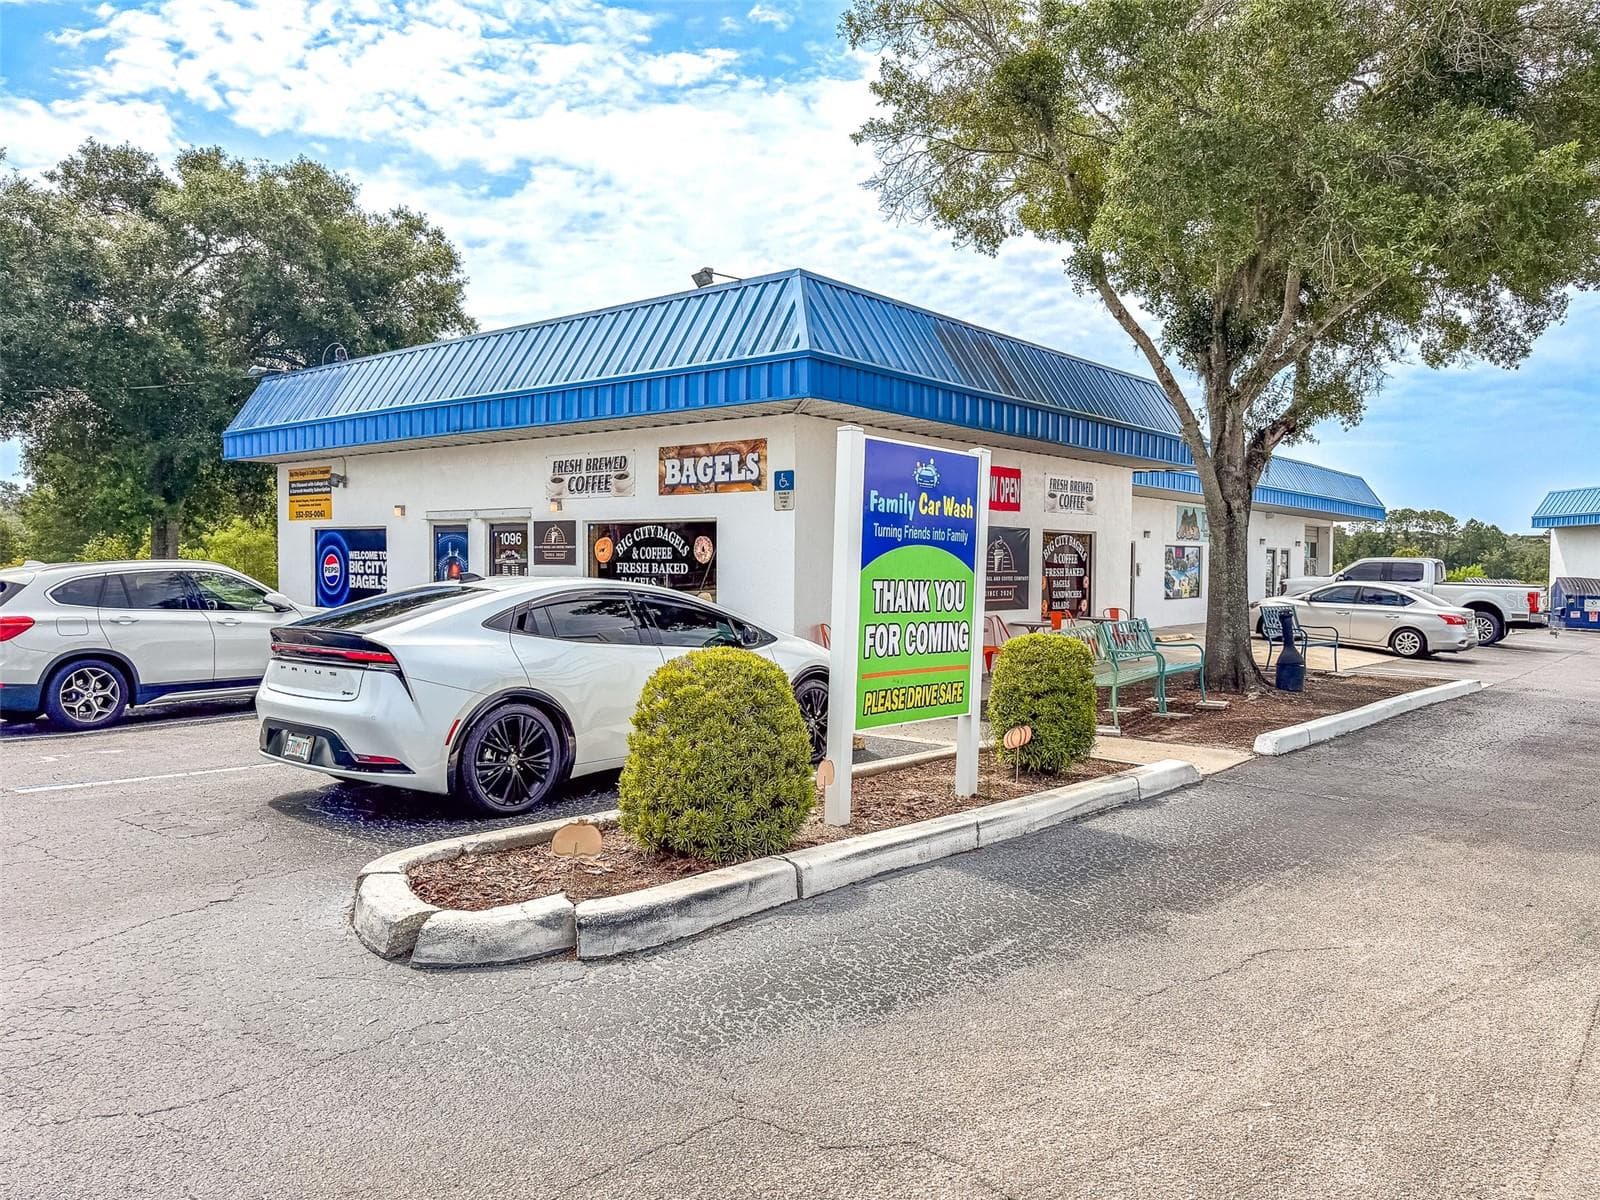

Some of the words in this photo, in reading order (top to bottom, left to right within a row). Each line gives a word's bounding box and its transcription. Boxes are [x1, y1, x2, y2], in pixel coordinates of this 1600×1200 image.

[552, 458, 582, 474] FRESH
[585, 455, 628, 472] BREWED
[664, 452, 760, 486] BAGELS
[567, 474, 612, 494] COFFEE
[999, 476, 1020, 504] OPEN
[1049, 477, 1069, 491] FRESH
[1069, 480, 1094, 493] BREWED
[869, 489, 916, 521] Family
[918, 491, 942, 516] Car
[943, 495, 974, 519] Wash
[1059, 493, 1086, 509] COFFEE
[499, 532, 522, 545] 1096
[615, 533, 634, 558] BIG
[633, 524, 657, 542] CITY
[657, 525, 690, 558] BAGELS
[873, 522, 903, 542] Turning
[903, 524, 931, 540] Friends
[932, 527, 946, 541] into
[946, 528, 969, 546] Family
[348, 550, 378, 560] WELCOME
[378, 550, 388, 560] TO
[632, 546, 639, 560] &
[639, 546, 673, 560] COFFEE
[1042, 540, 1056, 561] BIG
[1054, 534, 1069, 548] CITY
[1069, 535, 1088, 562] BAGELS
[348, 560, 365, 574] BIG
[365, 560, 388, 574] CITY
[1058, 553, 1079, 565] COFFEE
[324, 566, 340, 574] PEPSI
[616, 562, 650, 574] FRESH
[651, 562, 689, 575] BAKED
[1045, 567, 1065, 577] FRESH
[1065, 567, 1085, 577] BAKED
[349, 574, 388, 590] BAGELS
[1053, 579, 1071, 588] BAGELS
[872, 579, 932, 614] THANK
[933, 579, 967, 613] YOU
[1052, 590, 1082, 599] SANDWICHES
[1052, 601, 1070, 610] SALADS
[863, 622, 902, 660] FOR
[904, 621, 970, 656] COMING
[280, 665, 337, 677] PRIUS
[863, 686, 907, 716] PLEASE
[906, 682, 939, 710] DRIVE
[938, 680, 965, 706] SAFE
